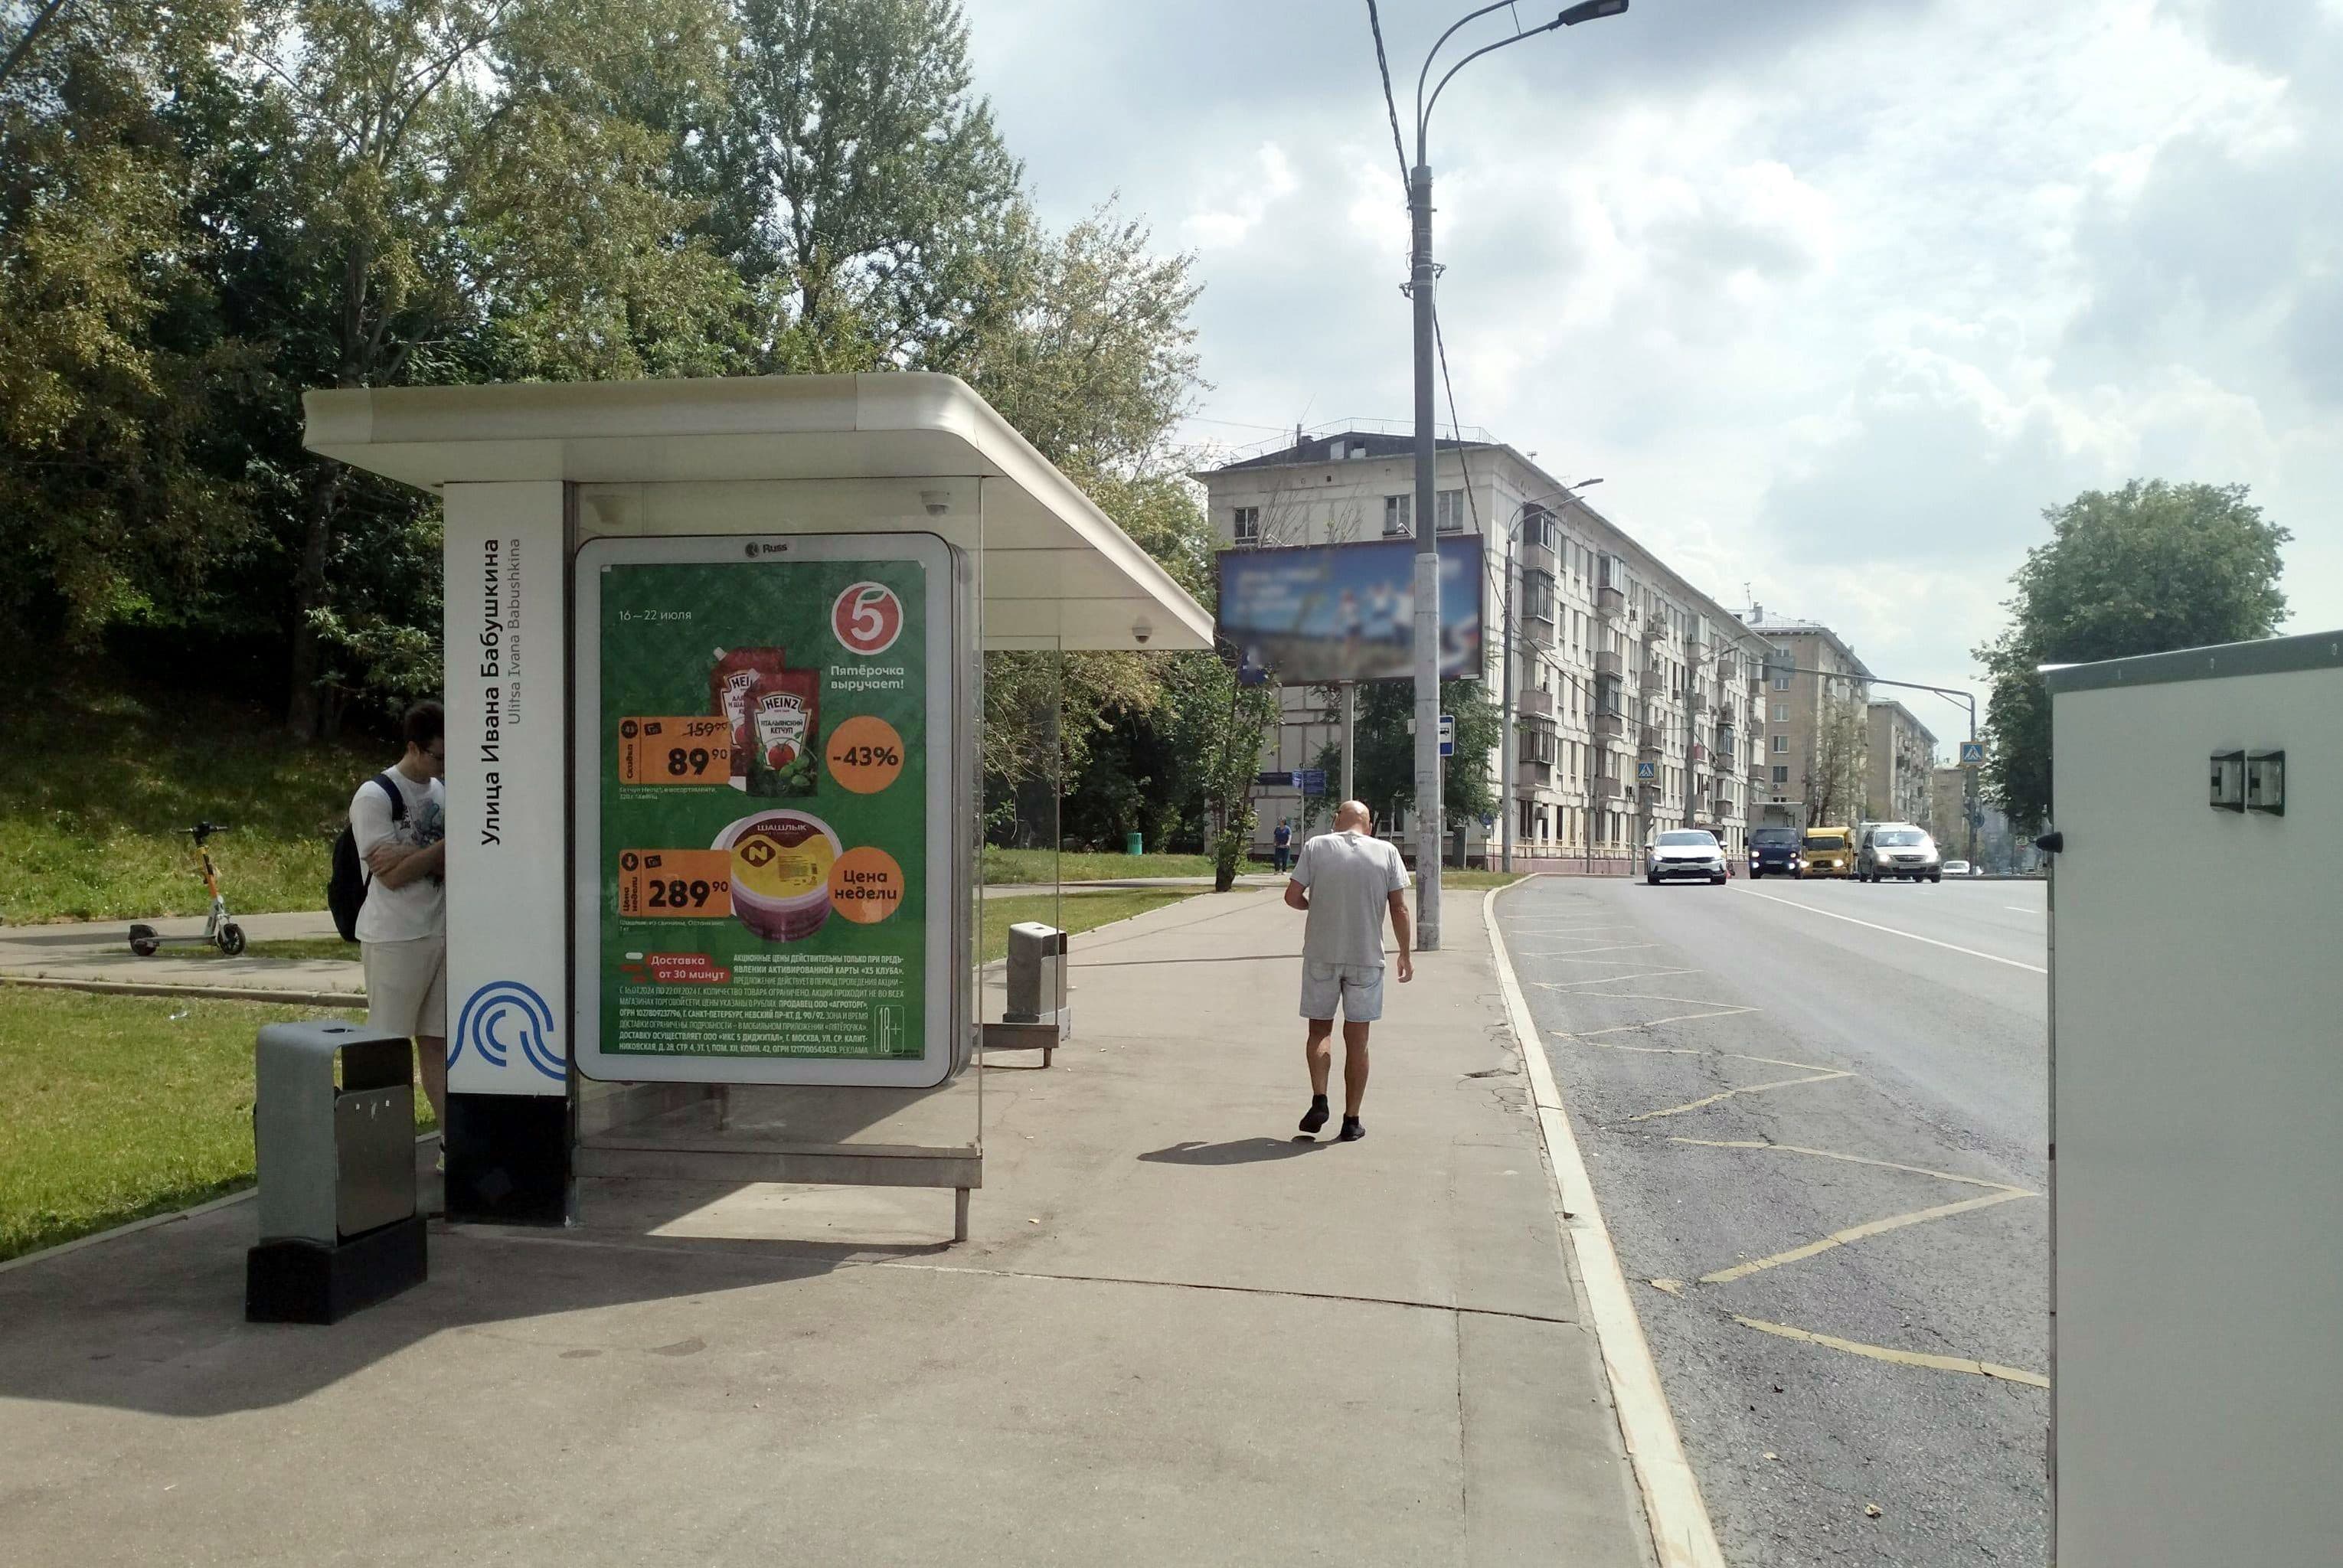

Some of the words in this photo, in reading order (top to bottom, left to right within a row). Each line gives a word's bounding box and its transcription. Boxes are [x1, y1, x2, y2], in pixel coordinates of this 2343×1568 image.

[763, 544, 788, 554] Russ
[507, 537, 521, 629] Babushkina
[480, 537, 504, 678] Бабушкина
[619, 610, 631, 621] 16
[643, 609, 657, 621] 22
[660, 611, 692, 621] июля
[508, 635, 521, 677] Ivana
[830, 664, 905, 678] Пятёрочка
[730, 675, 752, 688] HEI
[830, 679, 904, 691] выручает!
[508, 681, 521, 725] Ulitsa
[765, 697, 800, 710] HEINZ
[481, 686, 500, 763] Ивана
[760, 719, 804, 727] ИТАЛЬЯНСКИЙ
[832, 746, 899, 766] -43%
[481, 771, 502, 846] Улица
[843, 870, 888, 884] Цена
[630, 877, 639, 912] недели
[649, 880, 711, 908] 289
[712, 880, 729, 893] 90
[834, 886, 897, 900] недели
[651, 956, 705, 966] Доставка
[734, 954, 772, 964] АКЦИОННЫЕ
[773, 955, 789, 964] ЦЕНЫ
[790, 954, 842, 965] ДЕЙСТВИТЕЛЬНЫ
[843, 956, 867, 964] ТОЛЬКО
[868, 956, 880, 964] ПРИ
[658, 971, 672, 979] от
[673, 969, 687, 979] 30
[688, 972, 725, 982] минут
[768, 965, 834, 974] АКТИВИРОВАННОЙ
[779, 999, 813, 1008] ПРОДАВЕЦ
[828, 1000, 868, 1009] «АГРОТОРГ»,
[744, 1009, 774, 1018] НЕВСКИЙ
[619, 1031, 651, 1040] ДОСТАВКУ
[652, 1032, 702, 1040] ОСУЩЕСТВЛЯЕТ
[792, 1034, 821, 1042] МОСКВА,
[879, 1007, 902, 1054] 18+
